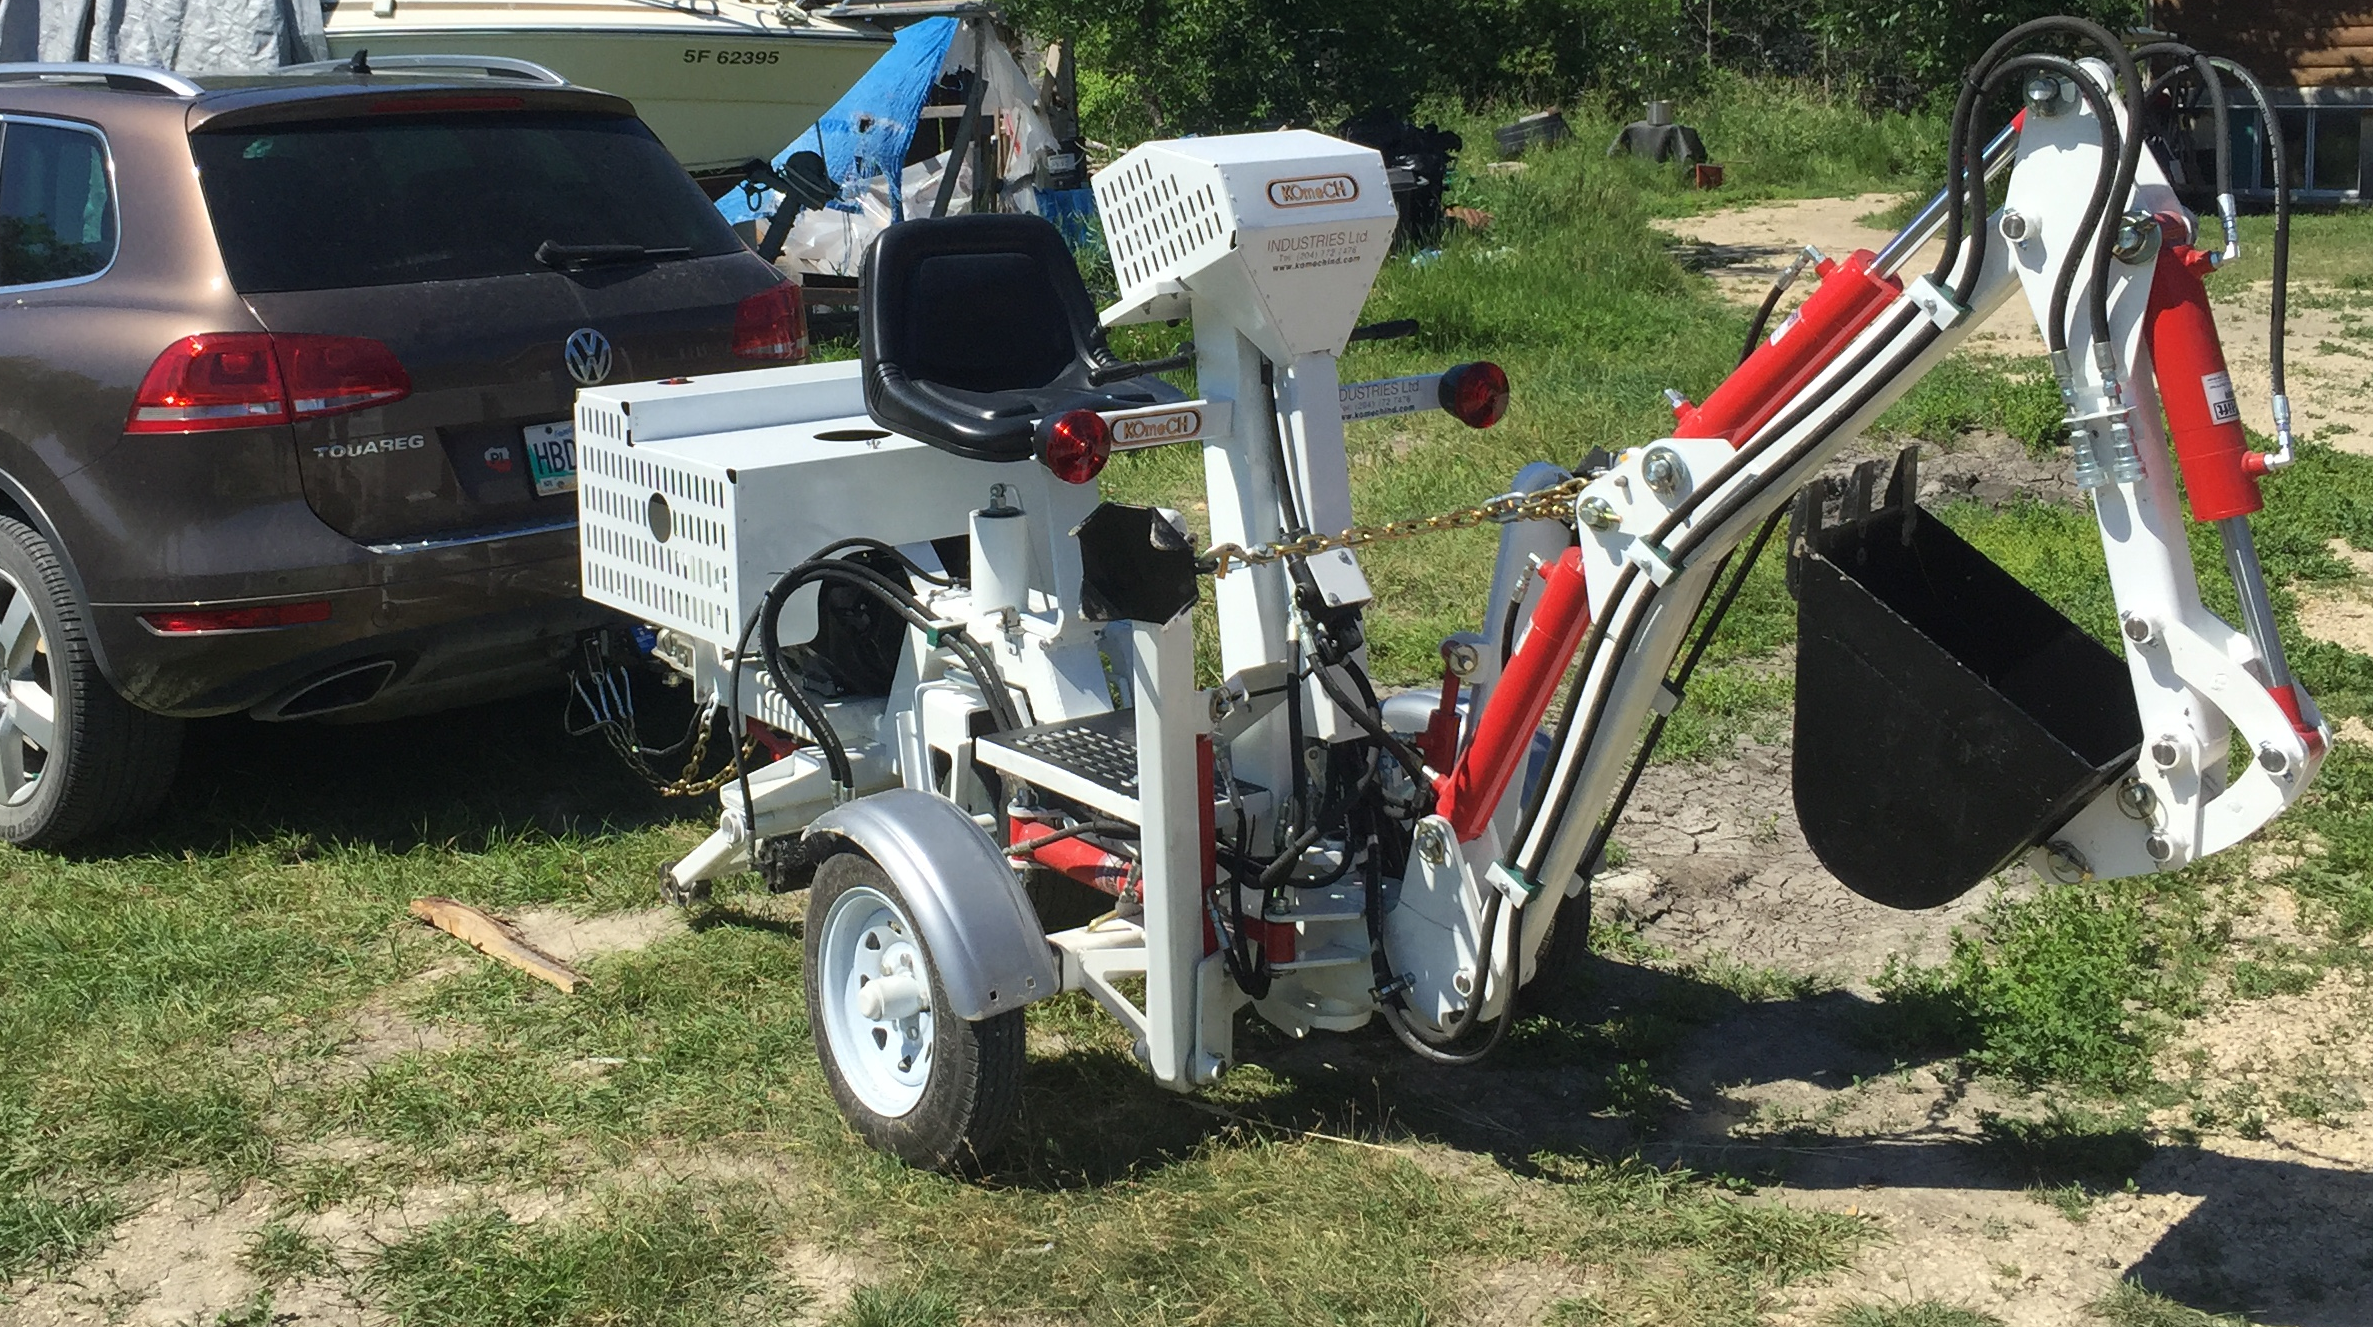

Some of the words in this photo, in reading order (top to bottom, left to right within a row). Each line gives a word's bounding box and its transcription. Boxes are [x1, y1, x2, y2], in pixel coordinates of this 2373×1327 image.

[683, 49, 711, 63] 5F
[717, 50, 779, 64] 62395
[1267, 231, 1346, 253] INDUSTRIES
[1348, 230, 1368, 244] Ltd
[1272, 255, 1361, 272] www.komechind.com
[1339, 381, 1399, 402] DUSTRIES
[1401, 379, 1419, 394] Ltd
[312, 434, 424, 459] TOUAREG
